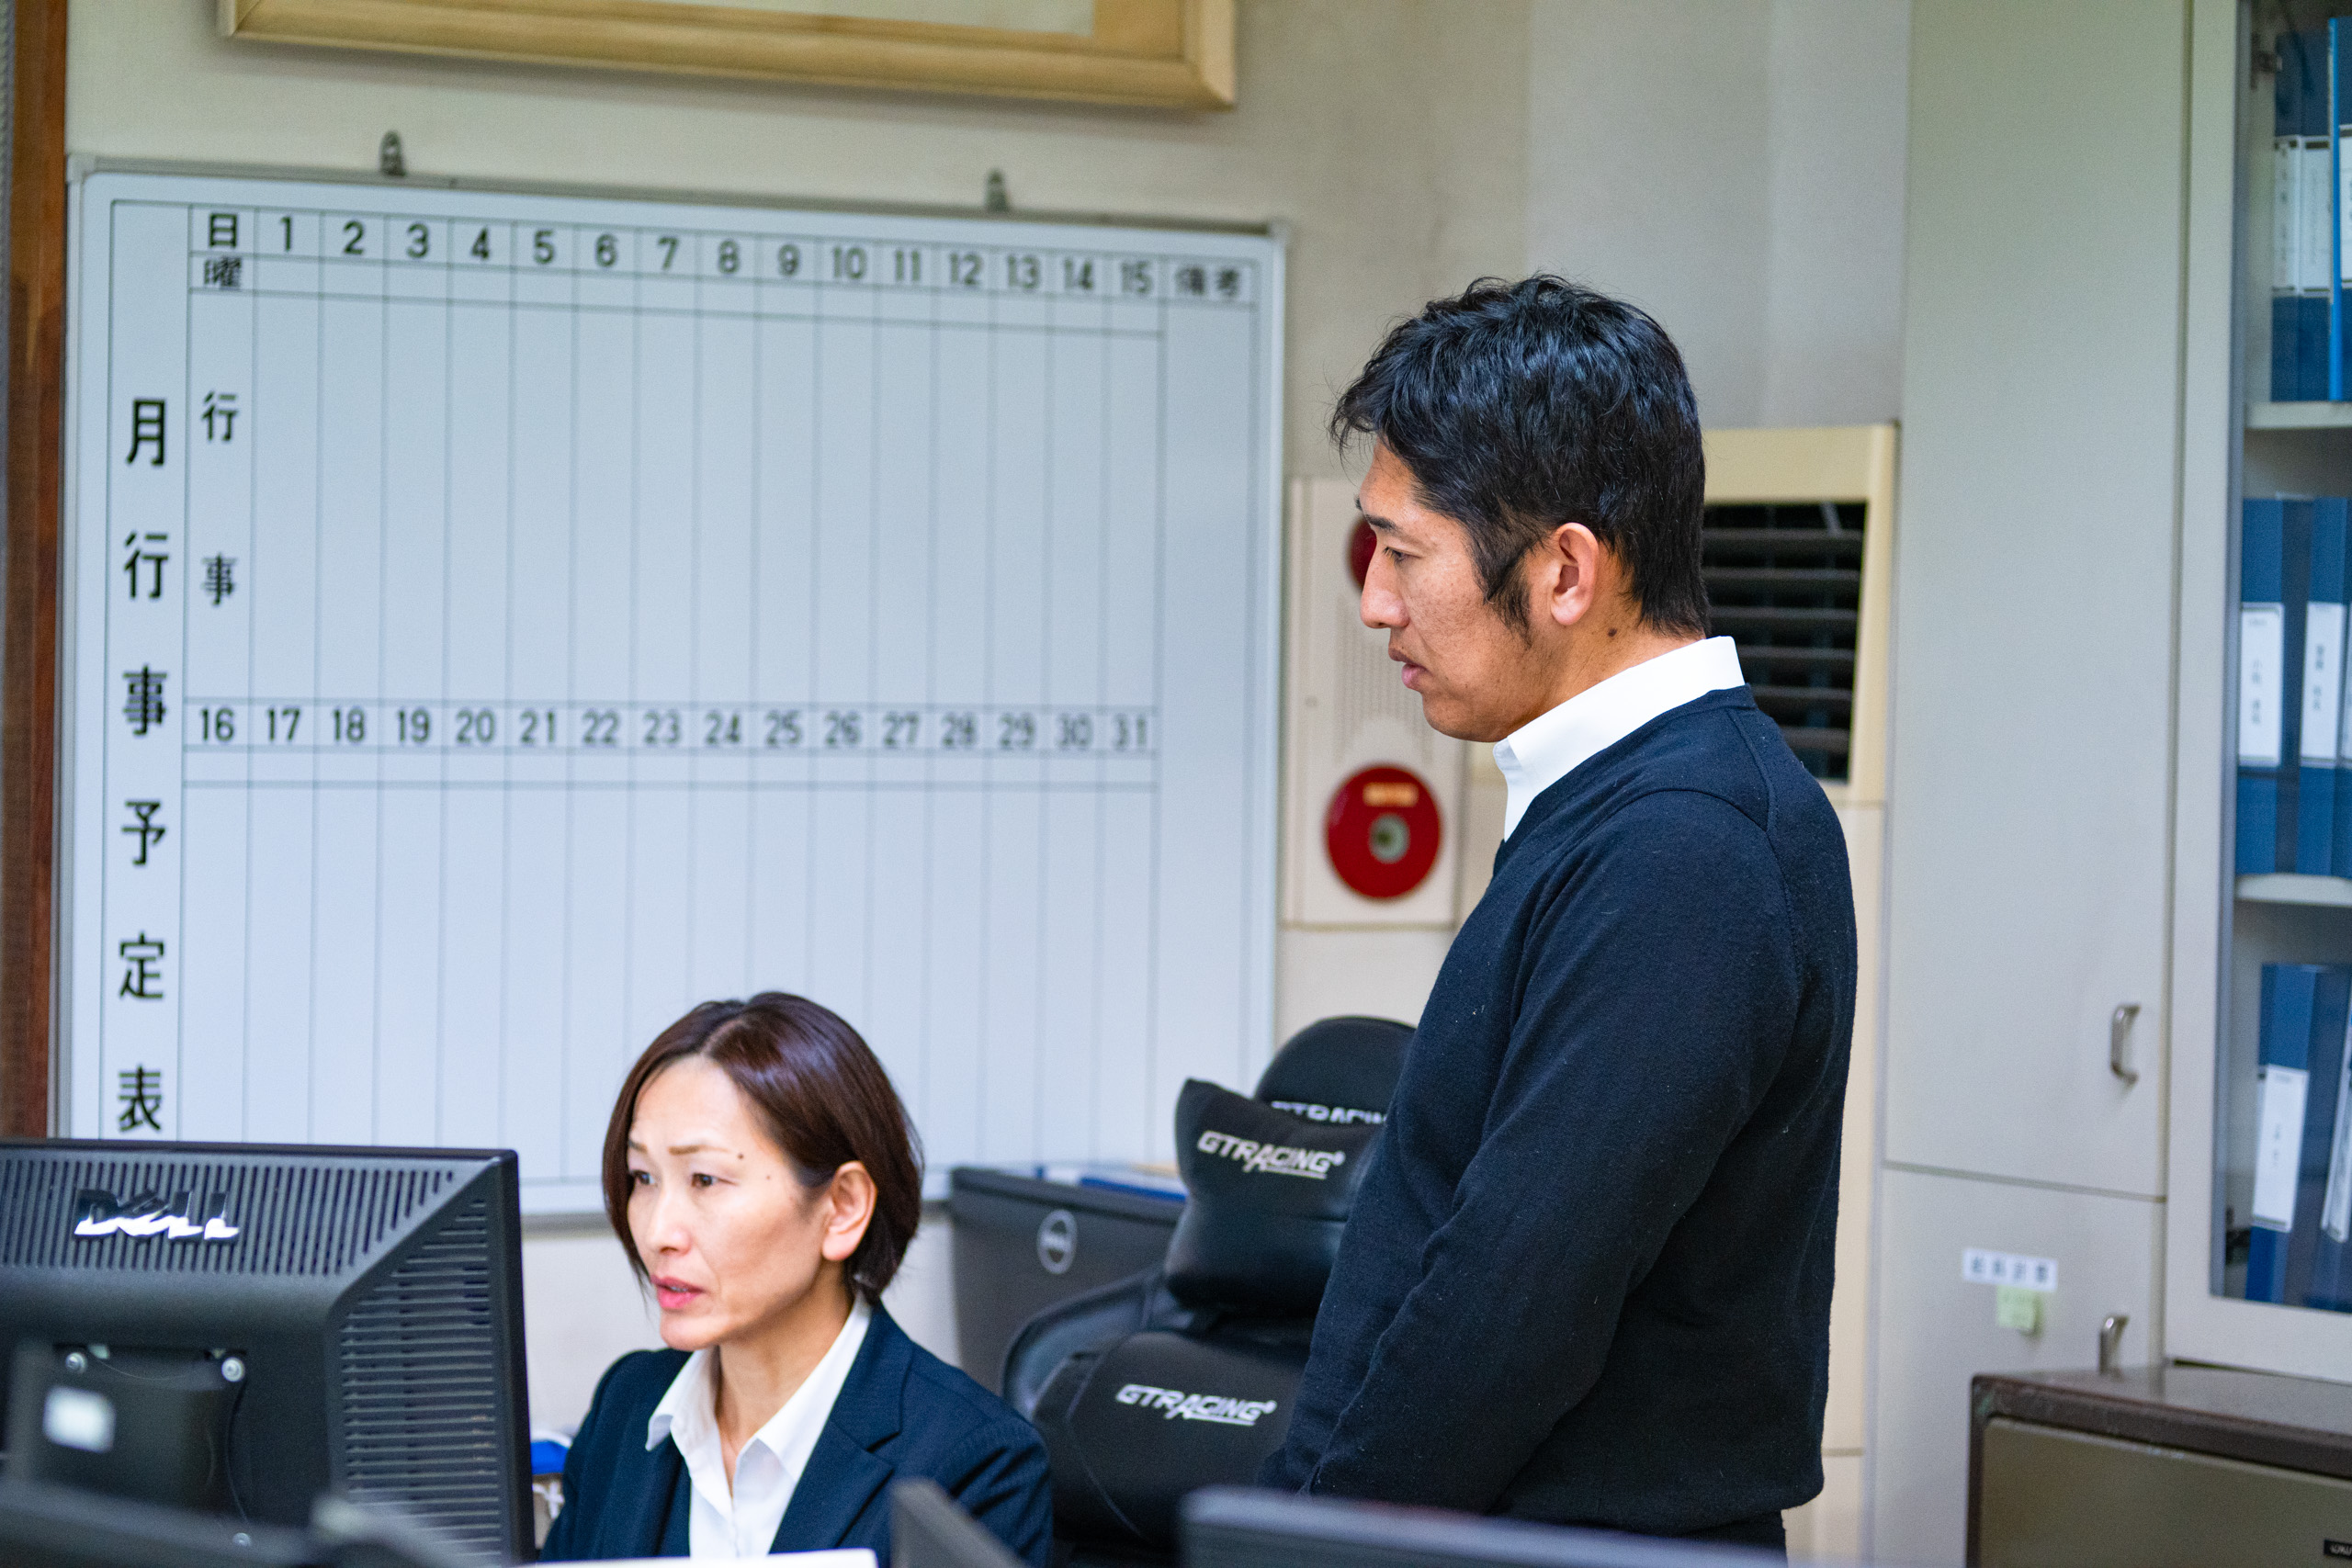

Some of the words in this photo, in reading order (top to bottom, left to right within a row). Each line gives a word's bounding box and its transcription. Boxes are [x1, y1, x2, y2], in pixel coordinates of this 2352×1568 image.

[204, 256, 242, 290] 曜
[208, 212, 239, 249] 日
[281, 215, 293, 252] 1
[343, 220, 365, 256] 2
[407, 222, 430, 259] 3
[471, 228, 490, 260] 4
[534, 229, 556, 265] 5
[595, 233, 617, 268] 6
[657, 235, 680, 270] 7
[718, 238, 741, 276] 8
[778, 243, 800, 277] 9
[832, 246, 866, 282] 10
[894, 248, 922, 283] 11
[949, 251, 982, 287] 12
[1006, 254, 1041, 290] 13
[1064, 259, 1093, 291] 14
[1121, 259, 1152, 297] 15
[201, 707, 235, 742] 16
[267, 707, 301, 741] 17
[333, 706, 366, 744] 18
[397, 707, 431, 744] 19
[456, 707, 496, 747] 20
[520, 709, 556, 747] 21
[582, 708, 620, 748] 22
[643, 709, 681, 748] 23
[706, 710, 741, 746] 24
[765, 709, 801, 749] 25
[825, 711, 860, 749] 26
[883, 711, 920, 749] 27
[943, 712, 977, 749] 28
[1000, 713, 1035, 749] 29
[1059, 714, 1091, 749] 30
[1114, 713, 1148, 749] 31
[118, 398, 169, 1133] 月行事予定表
[74, 1190, 239, 1240] DELL
